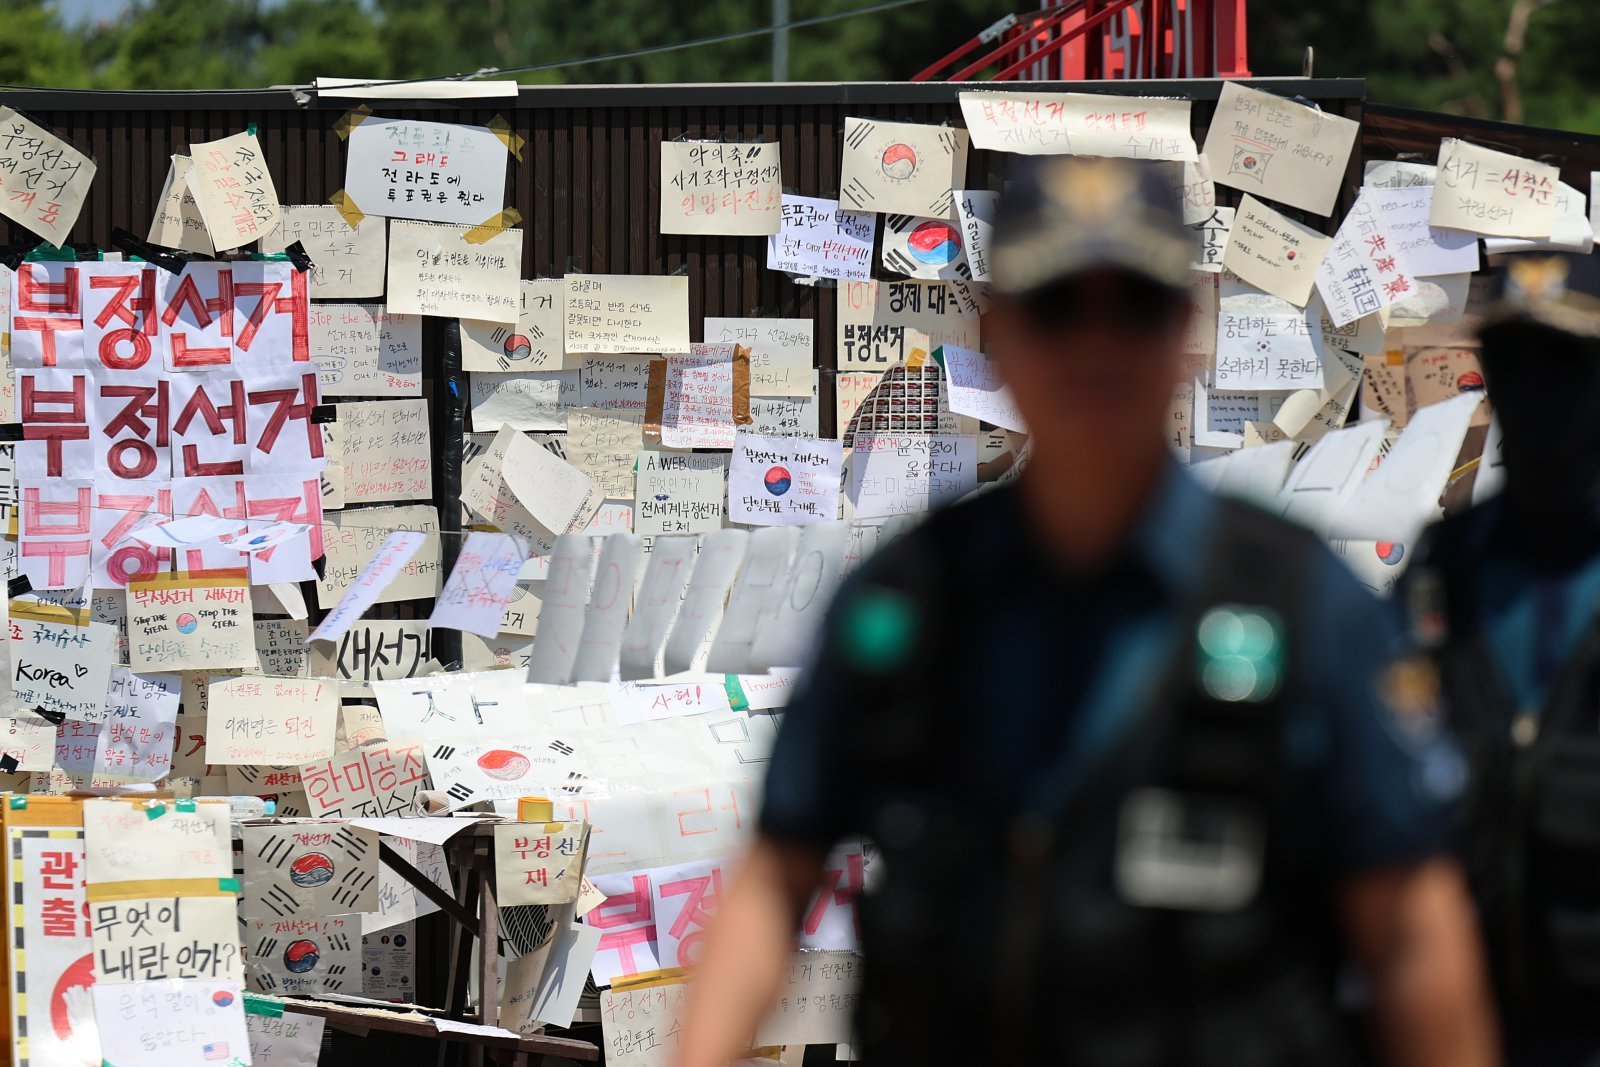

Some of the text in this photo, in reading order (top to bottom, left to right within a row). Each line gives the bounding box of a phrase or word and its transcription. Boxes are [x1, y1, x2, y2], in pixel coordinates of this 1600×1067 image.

[981, 100, 1065, 126] 부정선거
[2, 123, 82, 181] 부정선거
[1000, 128, 1185, 158] 재선거 수개표
[391, 151, 449, 168] 그래도
[382, 167, 462, 185] 전라도에
[1441, 157, 1480, 190] 선거
[387, 189, 448, 203] 투표권은
[781, 204, 830, 228] 투표권이
[324, 242, 361, 257] 수호
[568, 298, 602, 312] 초등학교
[607, 302, 625, 313] 반장
[888, 283, 922, 314] 경제
[14, 263, 311, 370] 부정선거
[340, 312, 359, 324] the
[1223, 315, 1279, 339] 중단하는
[1284, 318, 1313, 337] 자는
[843, 323, 906, 364] 부정선거
[584, 358, 627, 375] 부정선거
[1217, 356, 1324, 381] 승리하지 못한다
[22, 373, 325, 479] 부정선거
[580, 433, 635, 448] CBDC
[855, 437, 958, 457] 부정선거 윤석열이
[794, 450, 830, 467] 재선거
[662, 519, 691, 533] 단체
[134, 587, 246, 608] 부정선거 재선거
[221, 607, 239, 617] THE
[32, 622, 92, 649] 국제수사
[143, 624, 170, 637] STEAL
[211, 619, 239, 629] STEAL
[15, 658, 74, 690] Korea
[106, 677, 168, 700] 거인명부
[223, 681, 263, 698] 사전투표
[652, 685, 704, 711] 사형!
[744, 678, 798, 695] Investi
[224, 713, 317, 740] 이재명은 퇴진
[302, 745, 429, 810] 한미공조
[171, 817, 217, 837] 재선거
[292, 832, 332, 847] 재선거
[93, 896, 181, 942] 무엇이
[602, 990, 668, 1024] 부정선거
[612, 1027, 663, 1058] 당일투표
